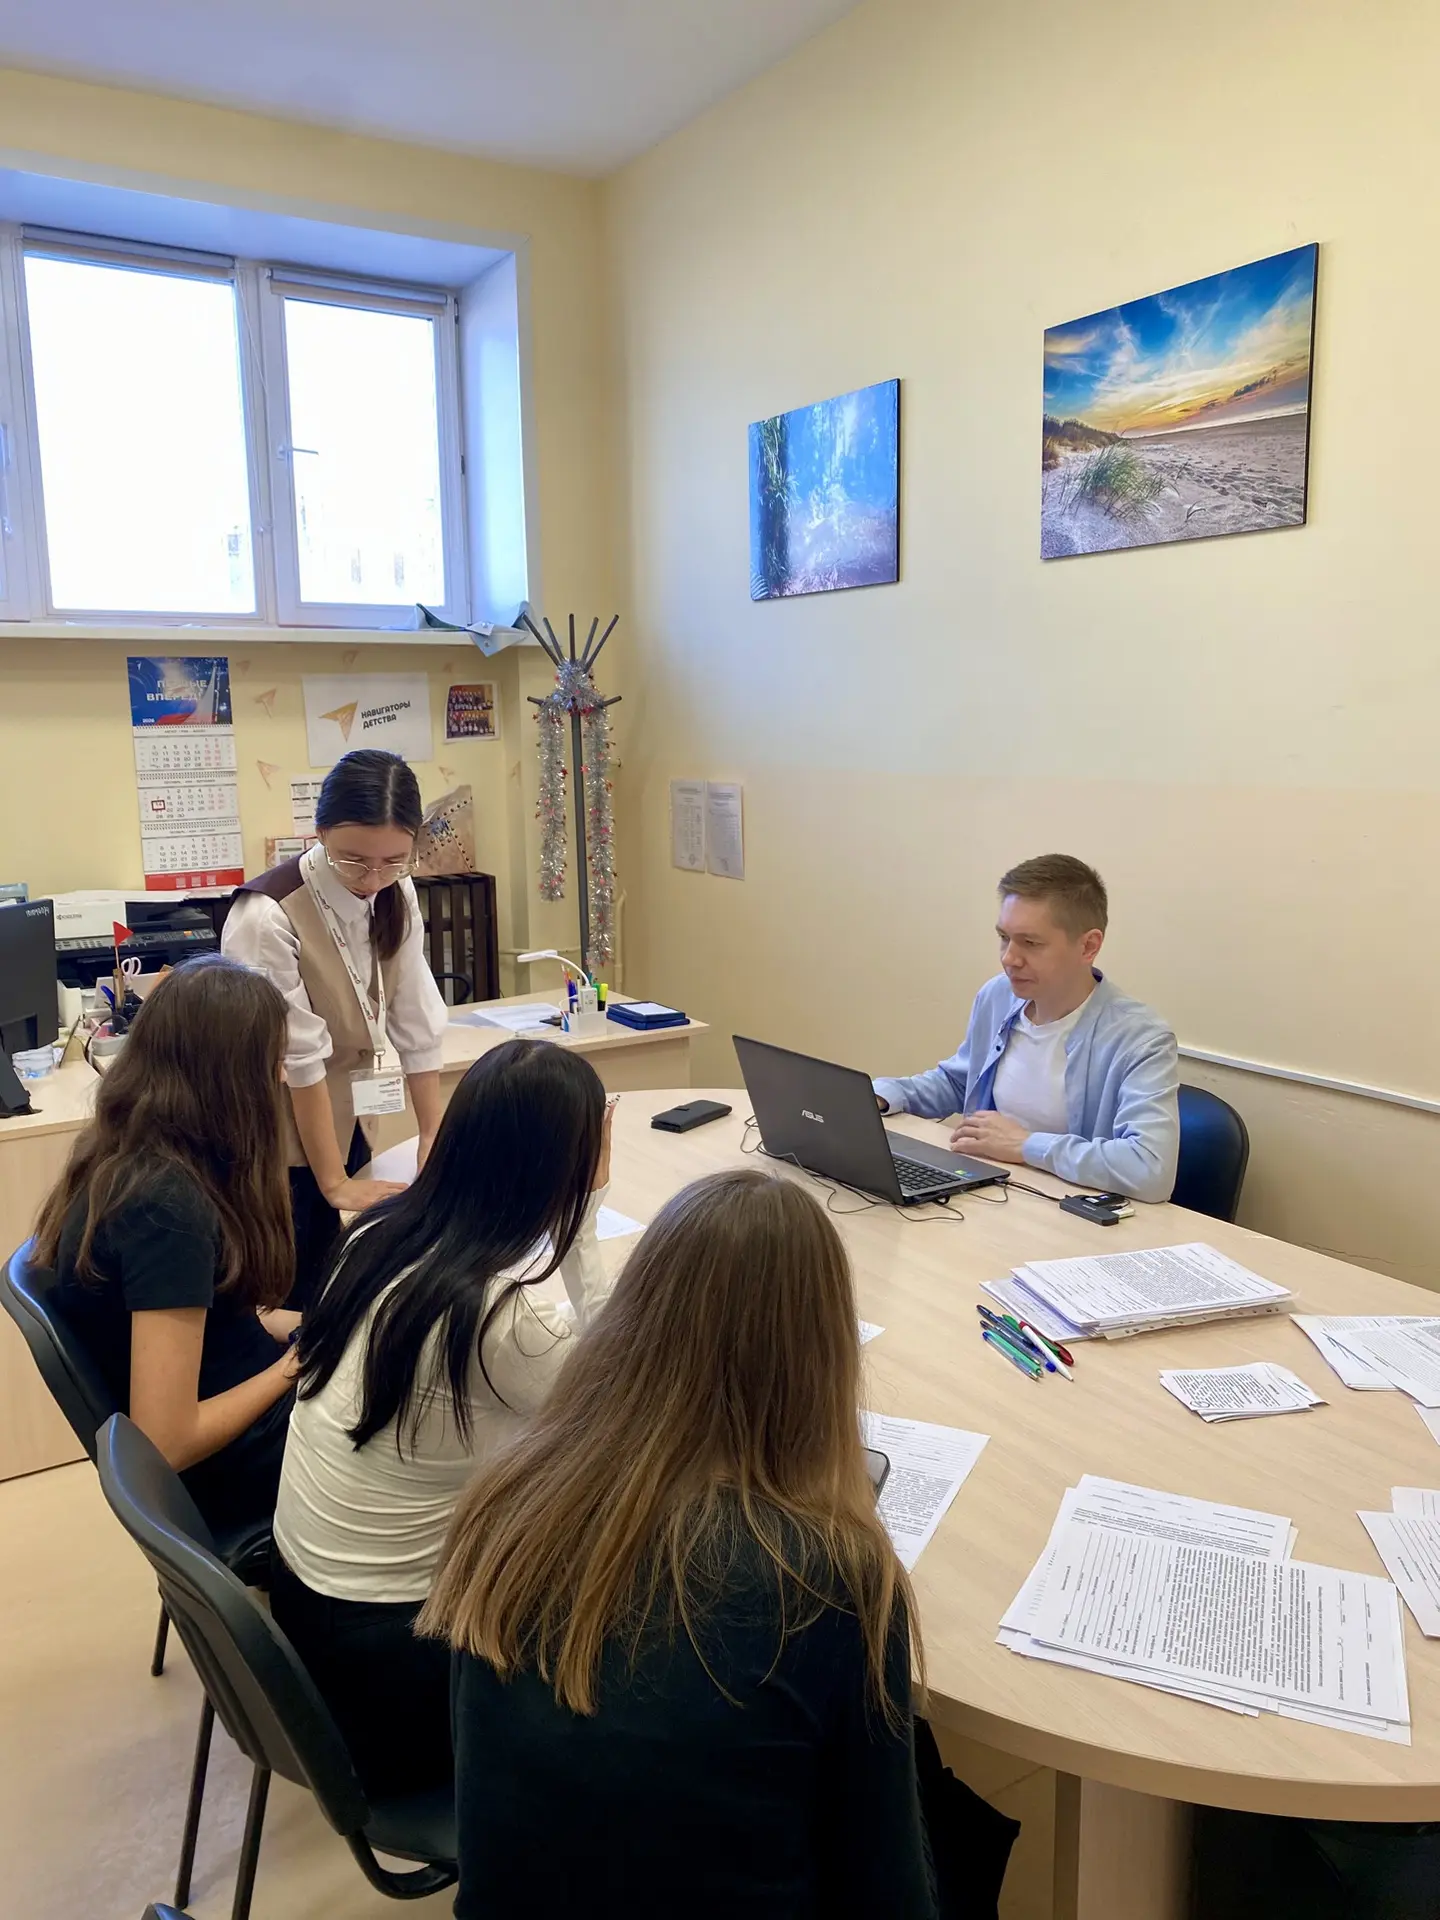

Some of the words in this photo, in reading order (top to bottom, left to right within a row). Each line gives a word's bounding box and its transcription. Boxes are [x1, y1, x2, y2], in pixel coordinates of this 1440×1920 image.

[361, 700, 411, 718] НАВИГАТОРЫ
[363, 714, 397, 729] ДЕТСТВА
[802, 1109, 824, 1123] ASUS
